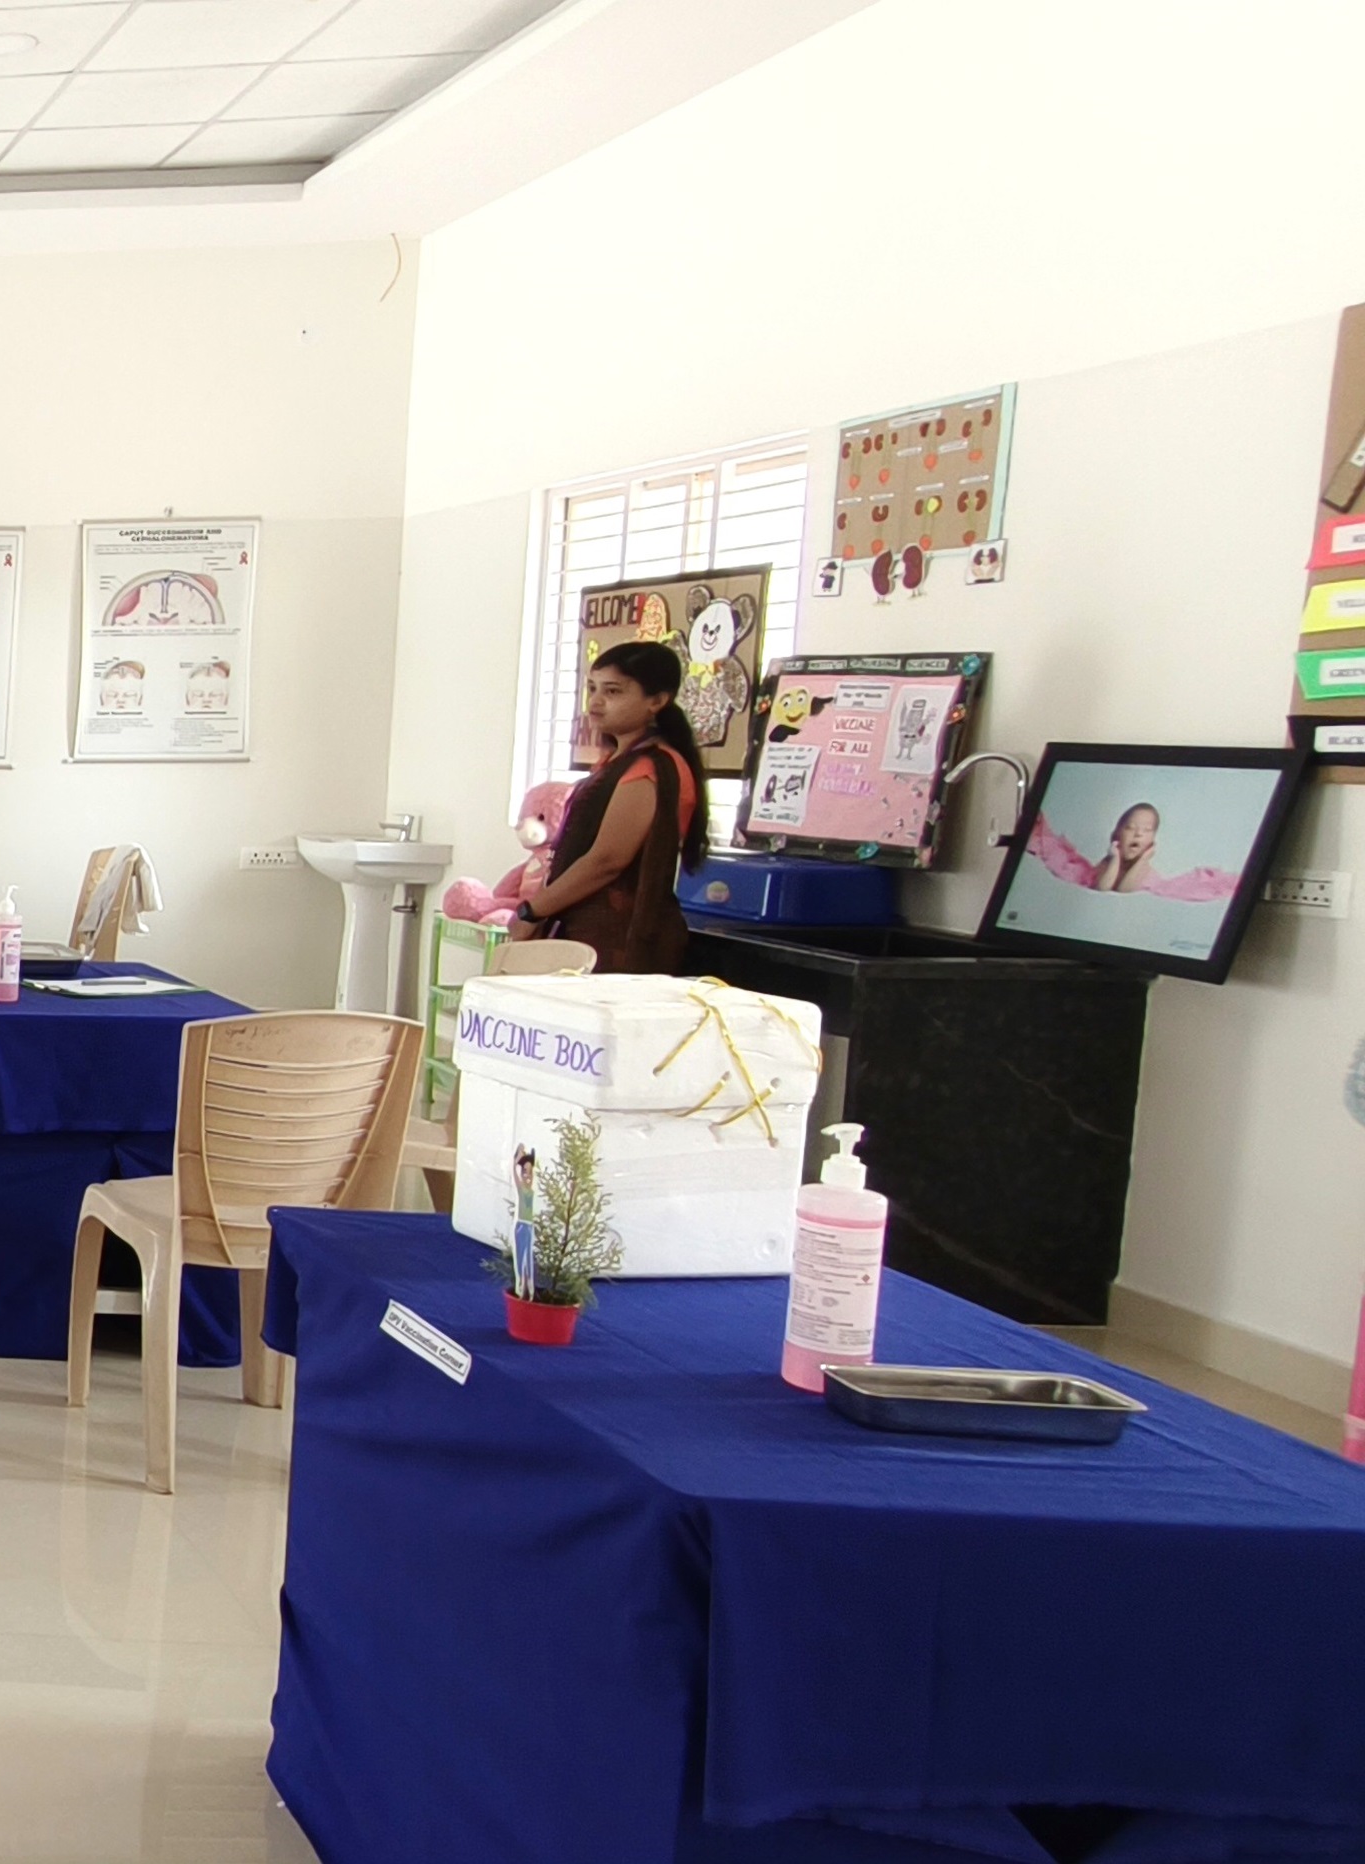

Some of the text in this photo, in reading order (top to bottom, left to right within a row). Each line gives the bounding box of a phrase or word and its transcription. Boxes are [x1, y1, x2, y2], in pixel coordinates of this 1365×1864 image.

[850, 742, 868, 754] ALL
[460, 1009, 605, 1076] VACCINE BOX
[401, 1320, 439, 1353] Vaccination
[439, 1347, 464, 1369] Corner
